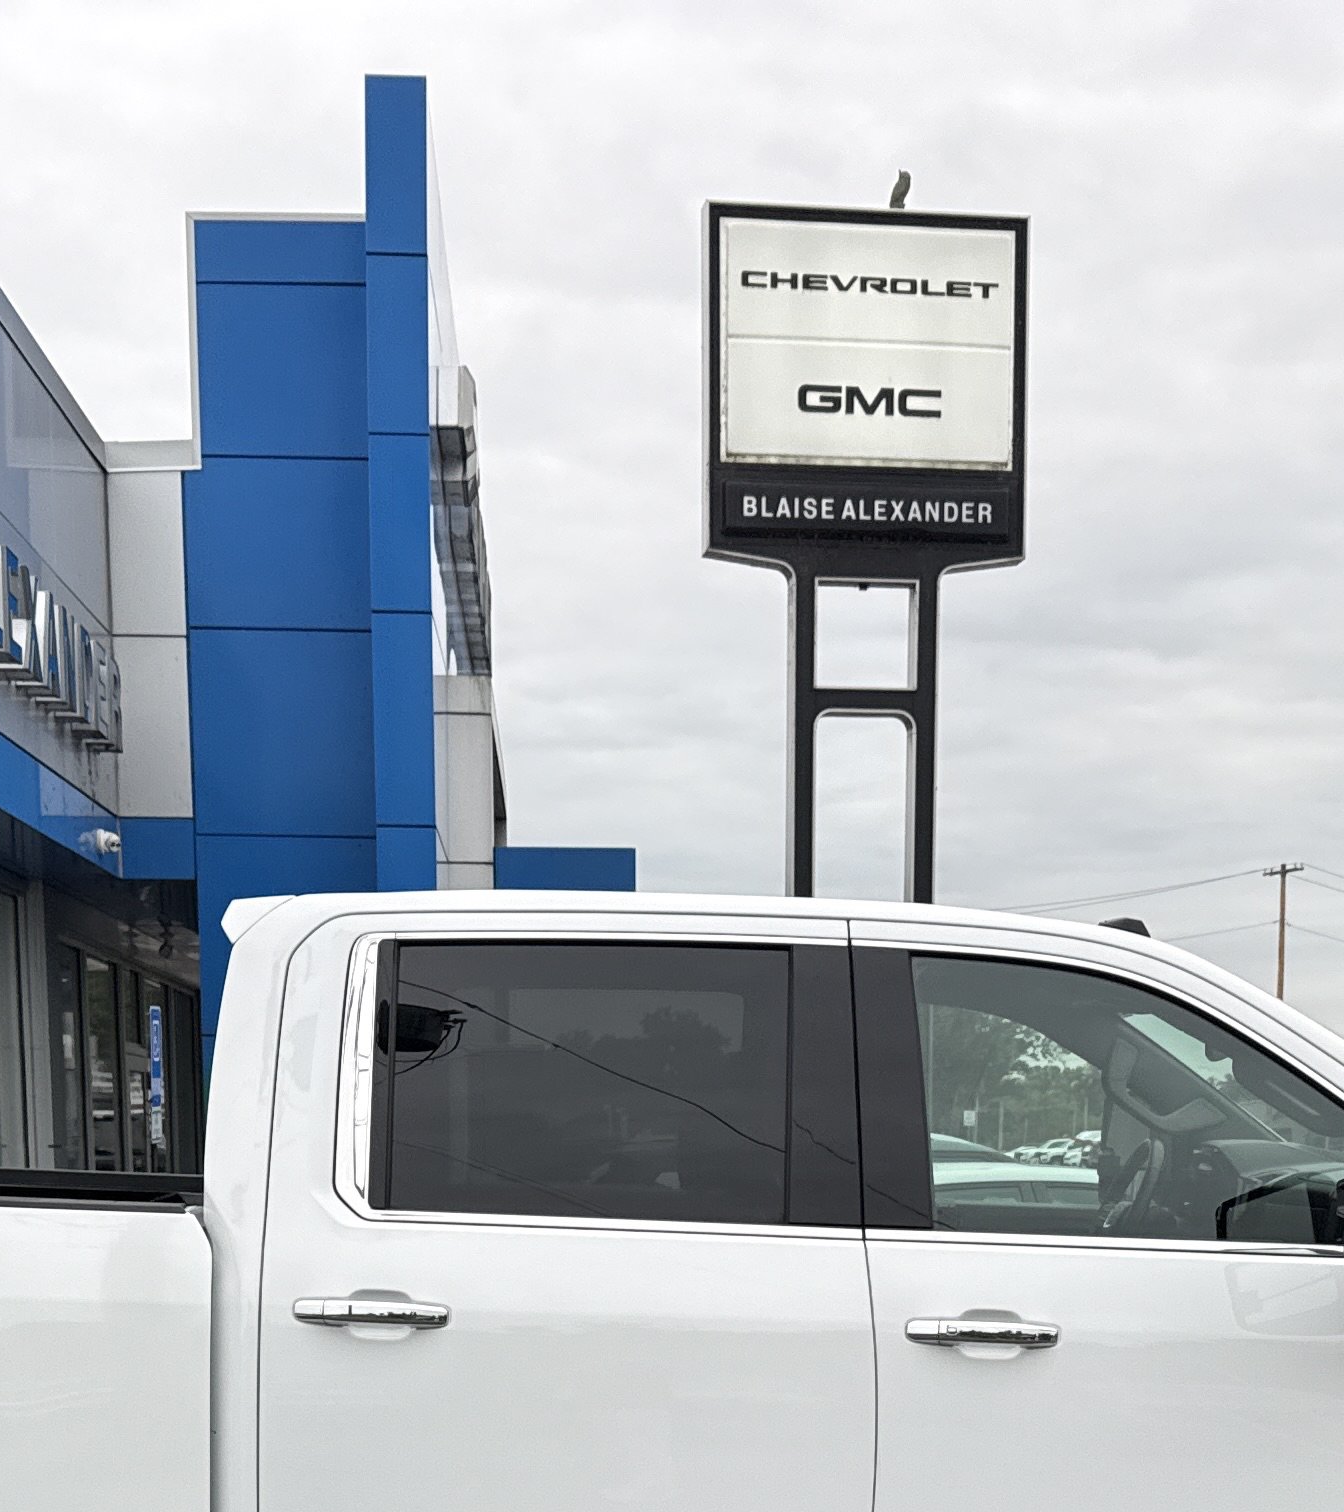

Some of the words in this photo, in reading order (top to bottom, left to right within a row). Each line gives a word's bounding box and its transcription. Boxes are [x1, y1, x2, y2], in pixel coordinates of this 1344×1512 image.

[740, 270, 999, 299] CHEVROLET
[797, 383, 942, 418] GMC
[742, 495, 835, 520] BLAISE
[841, 499, 993, 524] ALEXANDER
